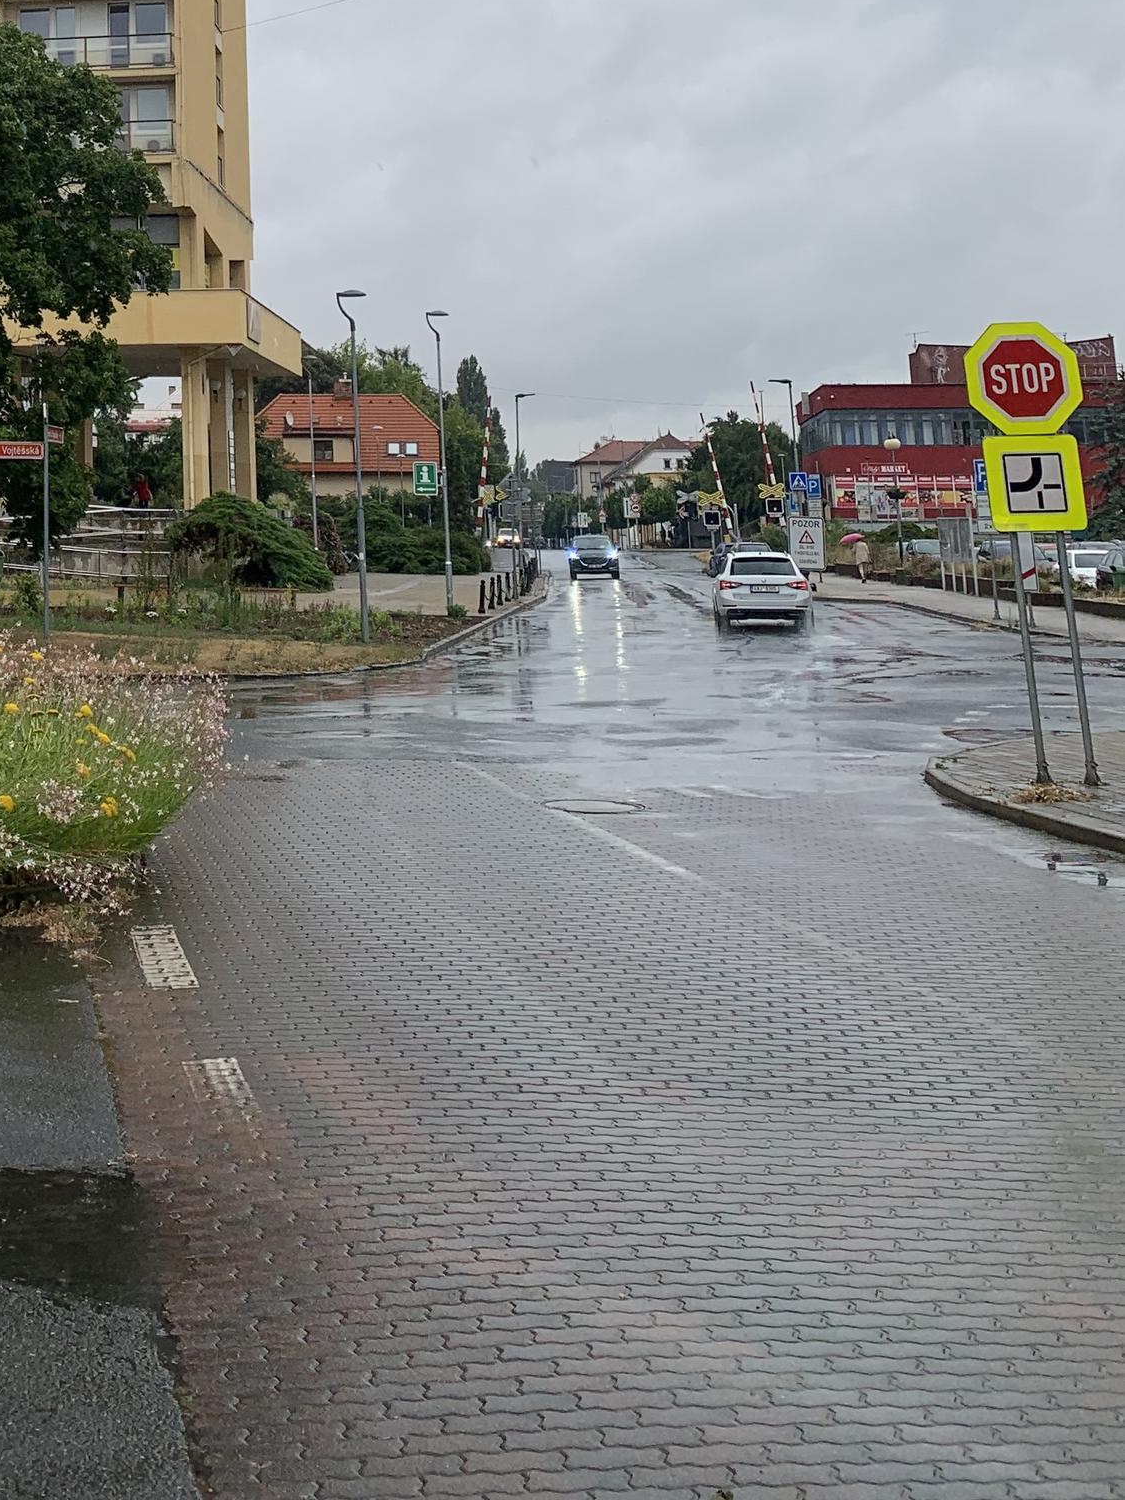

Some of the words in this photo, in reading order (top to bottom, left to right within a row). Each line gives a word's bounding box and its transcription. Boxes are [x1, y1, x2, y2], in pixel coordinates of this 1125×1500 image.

[990, 362, 1055, 395] STOP
[2, 445, 40, 457] Vojtěšská
[880, 465, 906, 473] MARKET
[809, 480, 817, 493] P
[792, 519, 820, 528] POZOR
